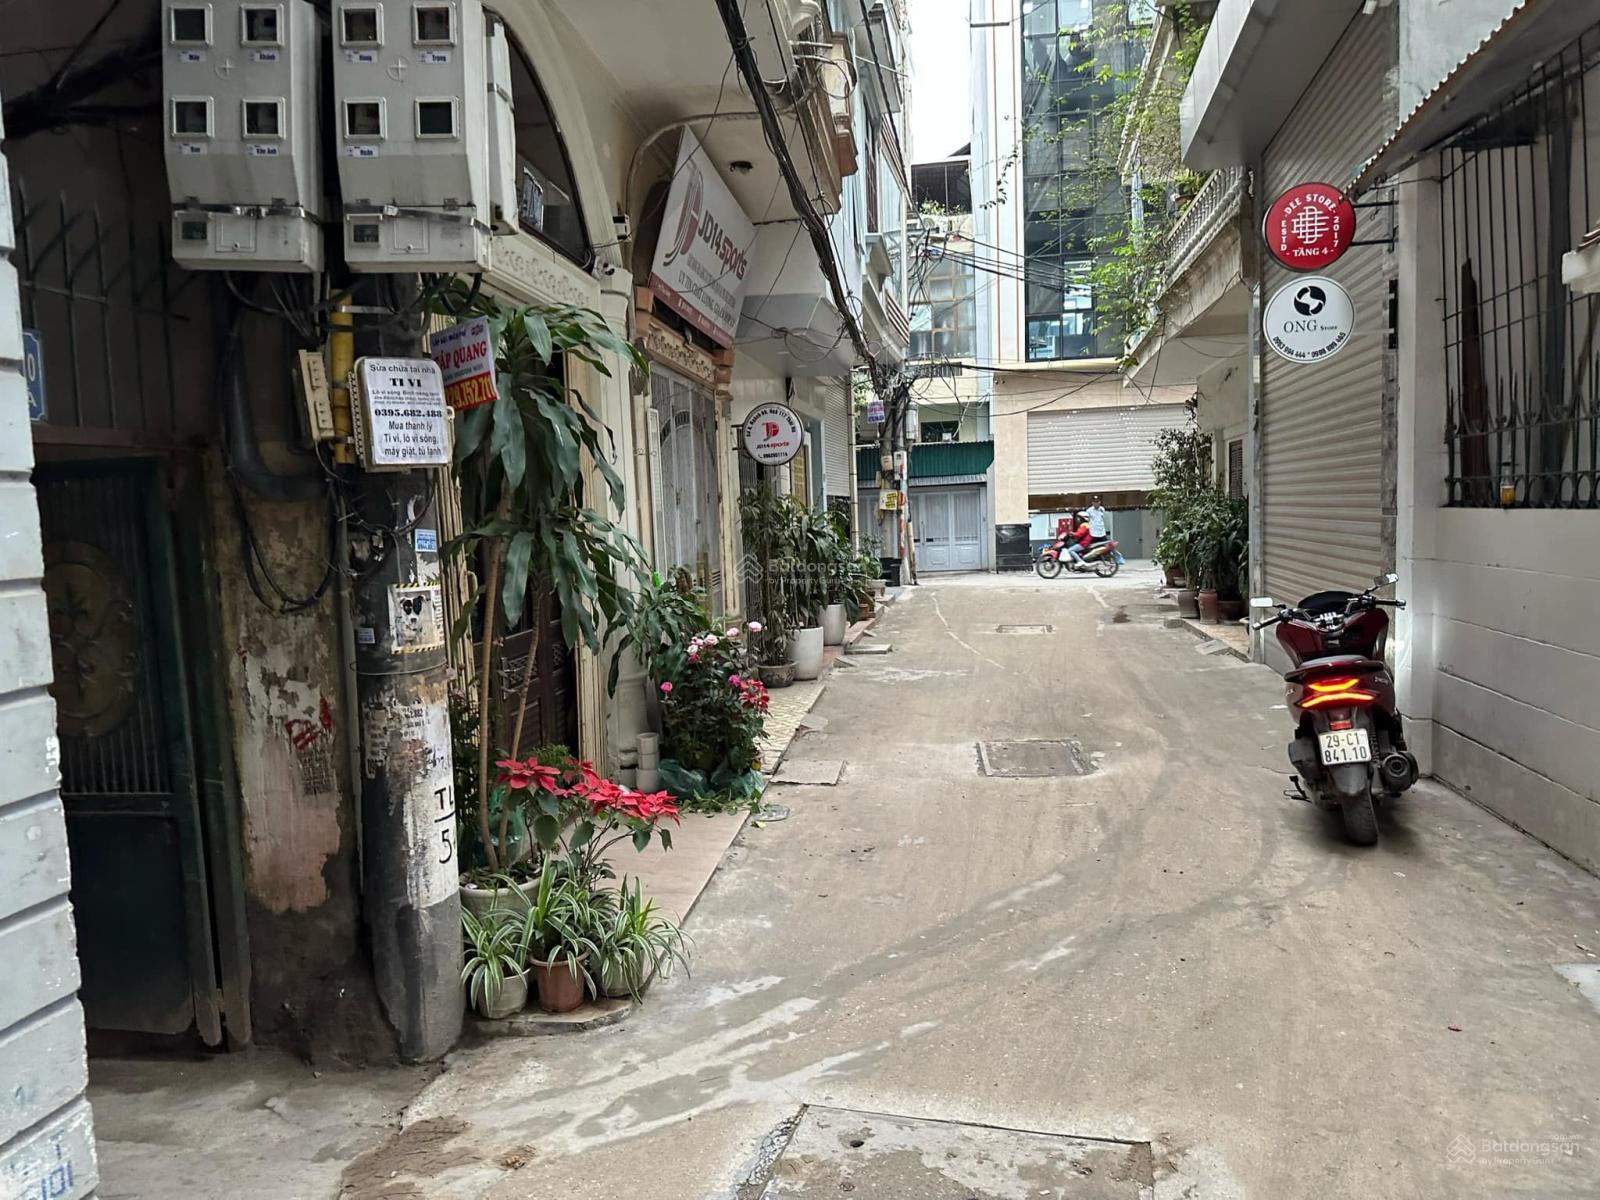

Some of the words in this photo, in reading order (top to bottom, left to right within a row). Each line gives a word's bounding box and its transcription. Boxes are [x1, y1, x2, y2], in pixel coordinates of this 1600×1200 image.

[1284, 197, 1302, 215] DEE
[1306, 194, 1336, 212] STORE
[1321, 247, 1328, 255] 4
[1283, 320, 1317, 333] ONG
[453, 341, 487, 368] QUANG
[389, 377, 404, 387] TI
[407, 378, 422, 387] VI
[388, 420, 404, 430] Mua
[405, 421, 425, 431] thanh
[384, 433, 391, 442] Ti
[1326, 732, 1360, 748] 29-C1
[1324, 746, 1367, 763] 841.10
[439, 828, 452, 864] 5
